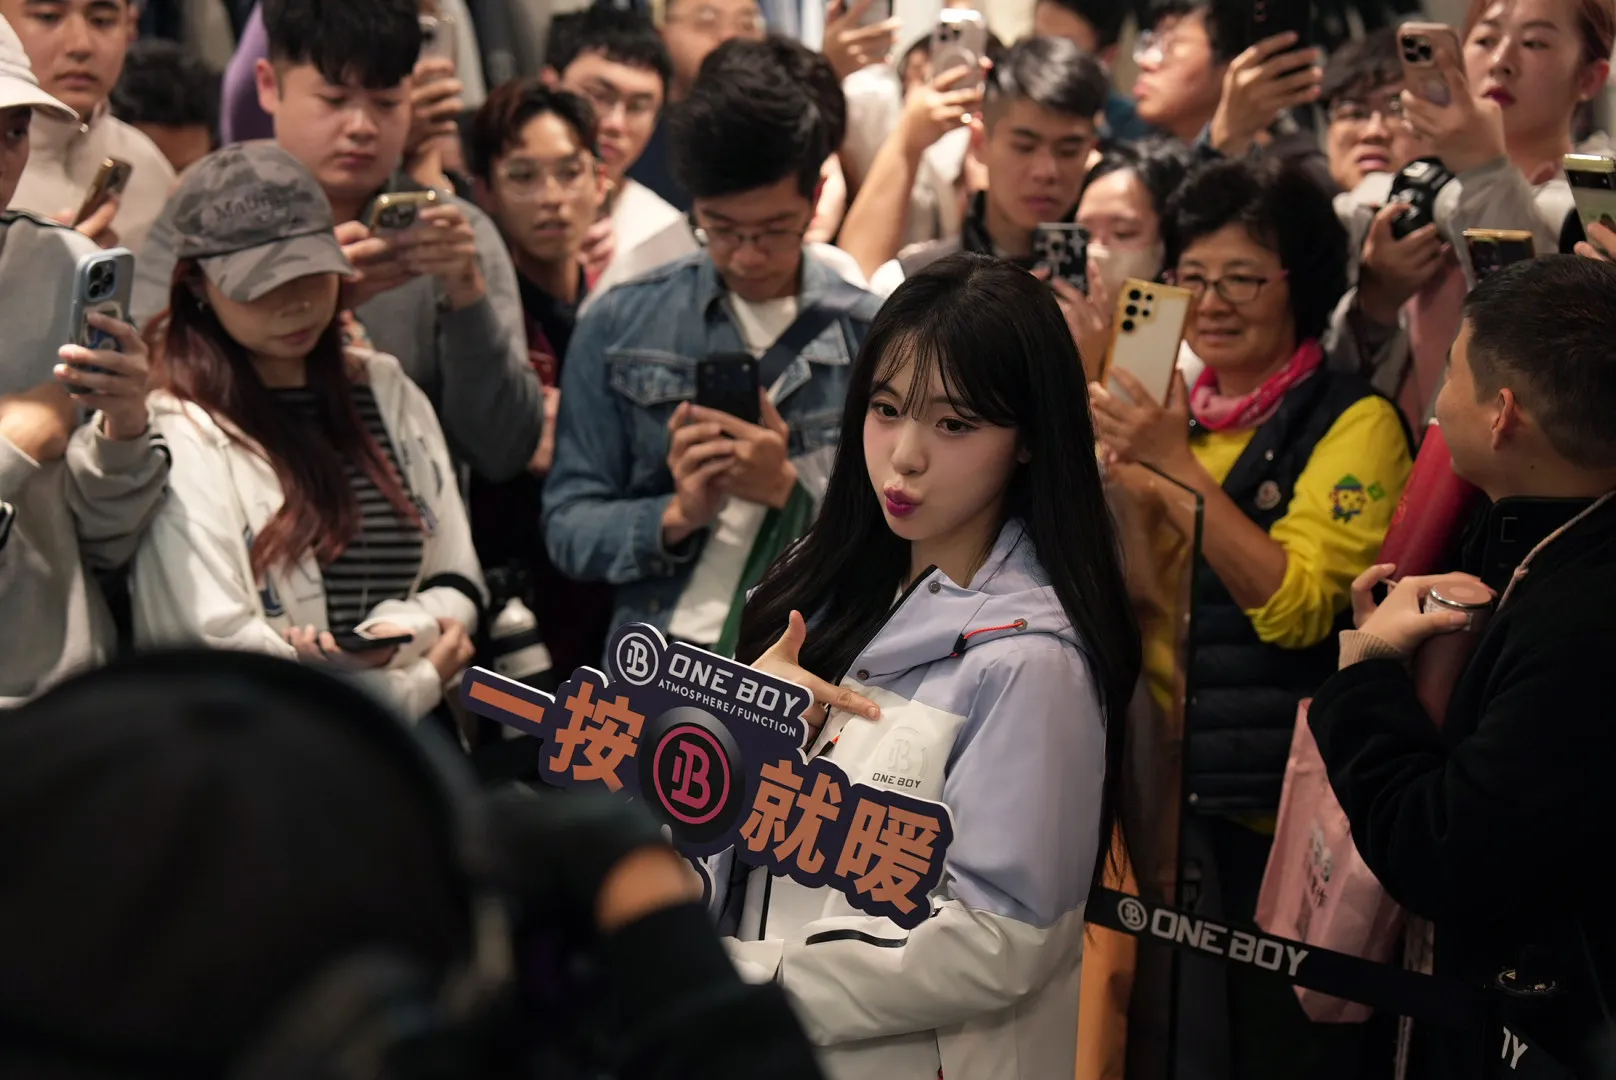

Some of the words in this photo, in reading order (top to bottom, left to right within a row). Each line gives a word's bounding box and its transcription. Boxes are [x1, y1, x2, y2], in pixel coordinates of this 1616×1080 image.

[658, 678, 797, 738] ATMOSPHERE/FUNCTION
[668, 653, 734, 695] ONE
[735, 677, 801, 718] BOY
[872, 772, 896, 785] ONE
[897, 776, 922, 789] BOY
[739, 759, 941, 915] 就暖
[1151, 907, 1228, 955] ONE
[1228, 930, 1309, 977] BOY
